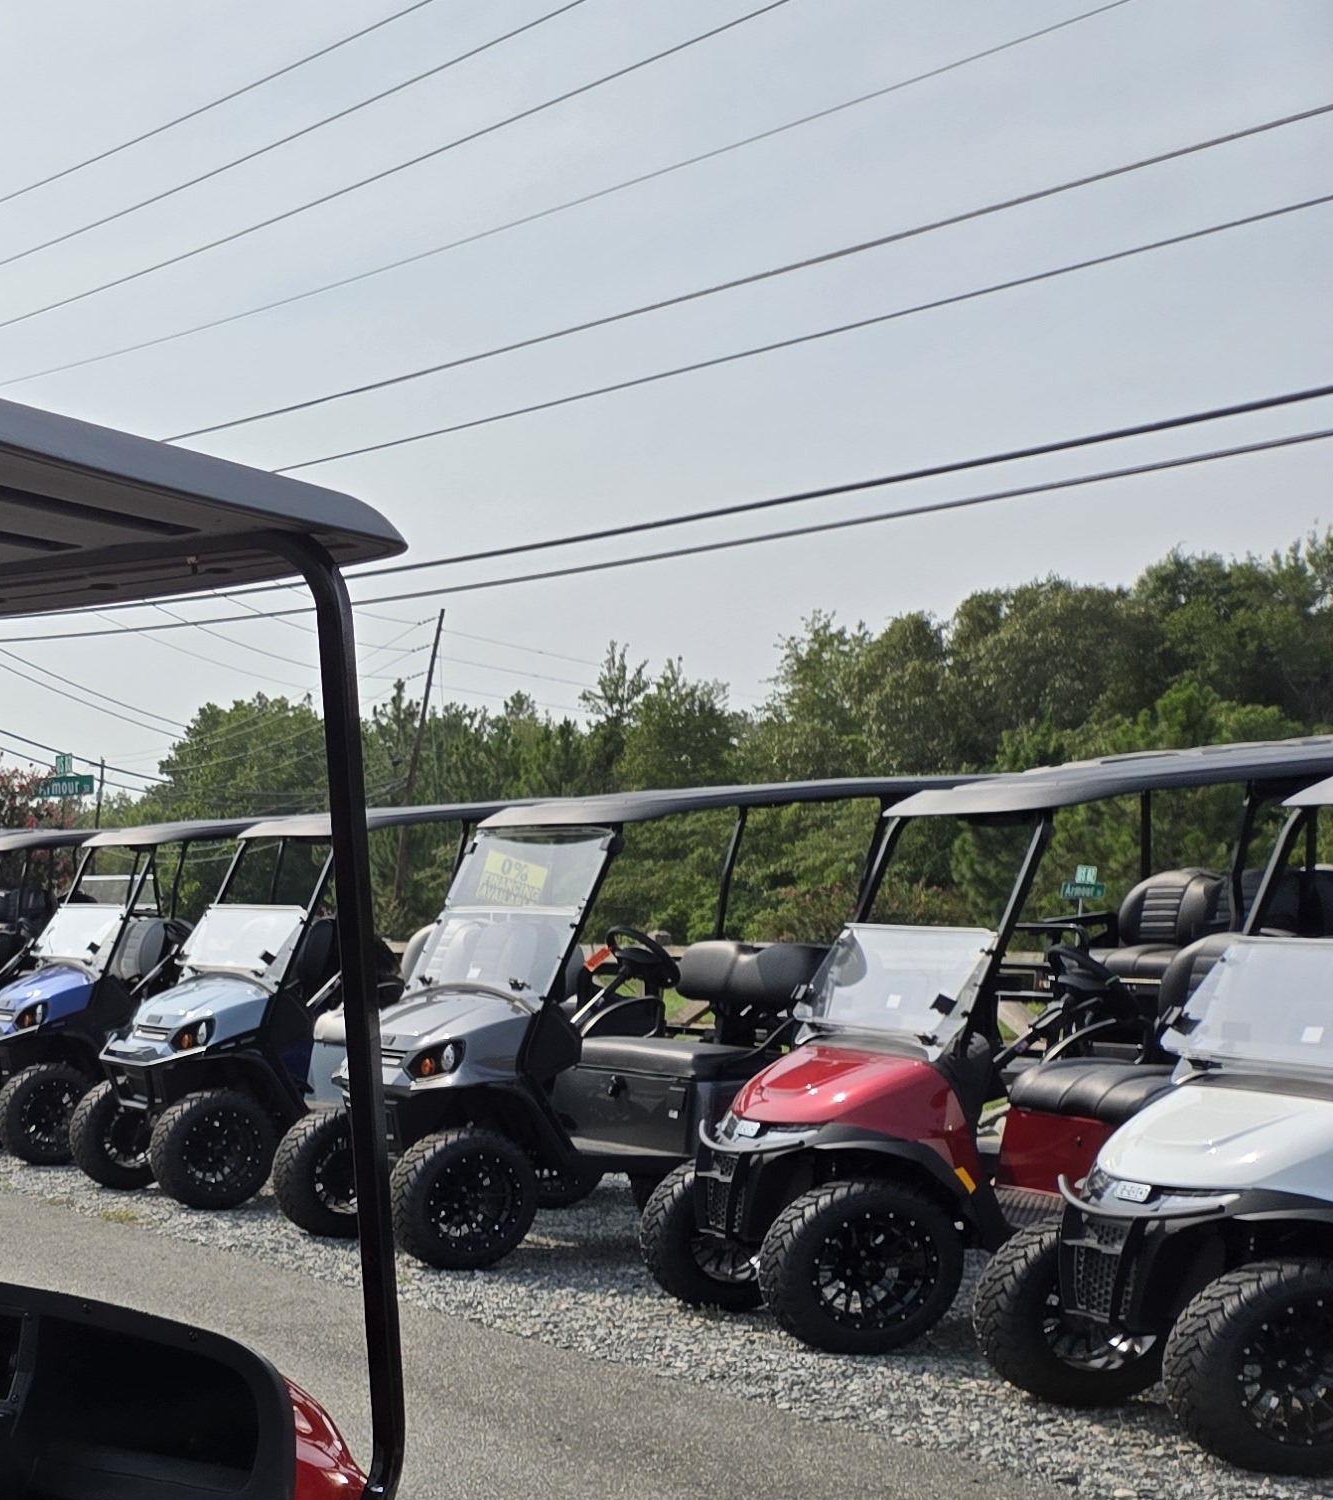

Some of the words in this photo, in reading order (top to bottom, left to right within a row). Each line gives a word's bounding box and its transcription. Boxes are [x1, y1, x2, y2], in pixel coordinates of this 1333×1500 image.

[39, 781, 79, 796] Armour
[501, 858, 529, 881] 0%
[485, 873, 540, 901] FINANCING
